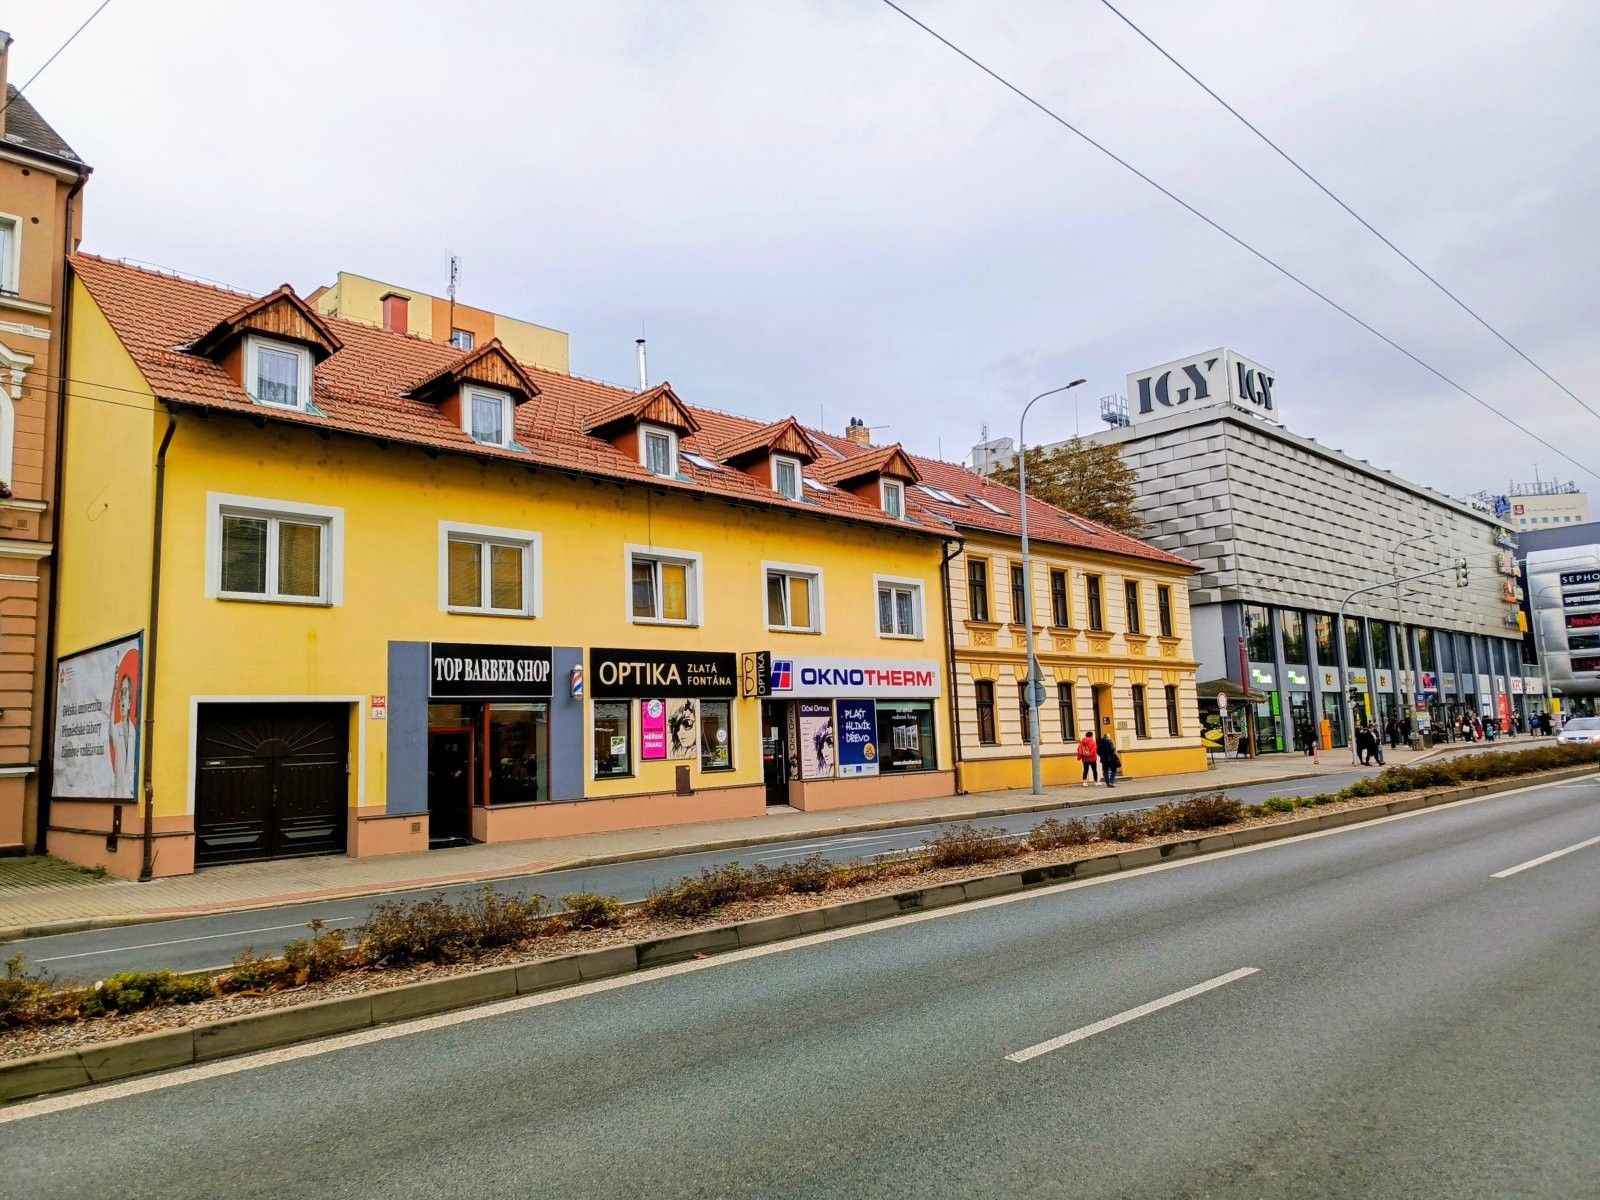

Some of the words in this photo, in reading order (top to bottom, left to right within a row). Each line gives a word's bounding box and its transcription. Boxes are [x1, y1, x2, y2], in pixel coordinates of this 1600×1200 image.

[1137, 358, 1219, 414] IGY
[1236, 361, 1275, 410] IGY
[1562, 573, 1600, 583] SEPHO
[434, 657, 463, 681] TOP
[464, 658, 516, 682] BARBER
[516, 659, 550, 682] SHOP
[599, 661, 682, 686] OPTIKA
[687, 662, 718, 674] ZLATÁ
[687, 674, 732, 686] FONTÁNA
[757, 652, 766, 695] OPTIKA
[800, 667, 933, 687] OKNOTHERM
[845, 719, 872, 731] HLINÍK
[845, 731, 871, 743] DŘEVO
